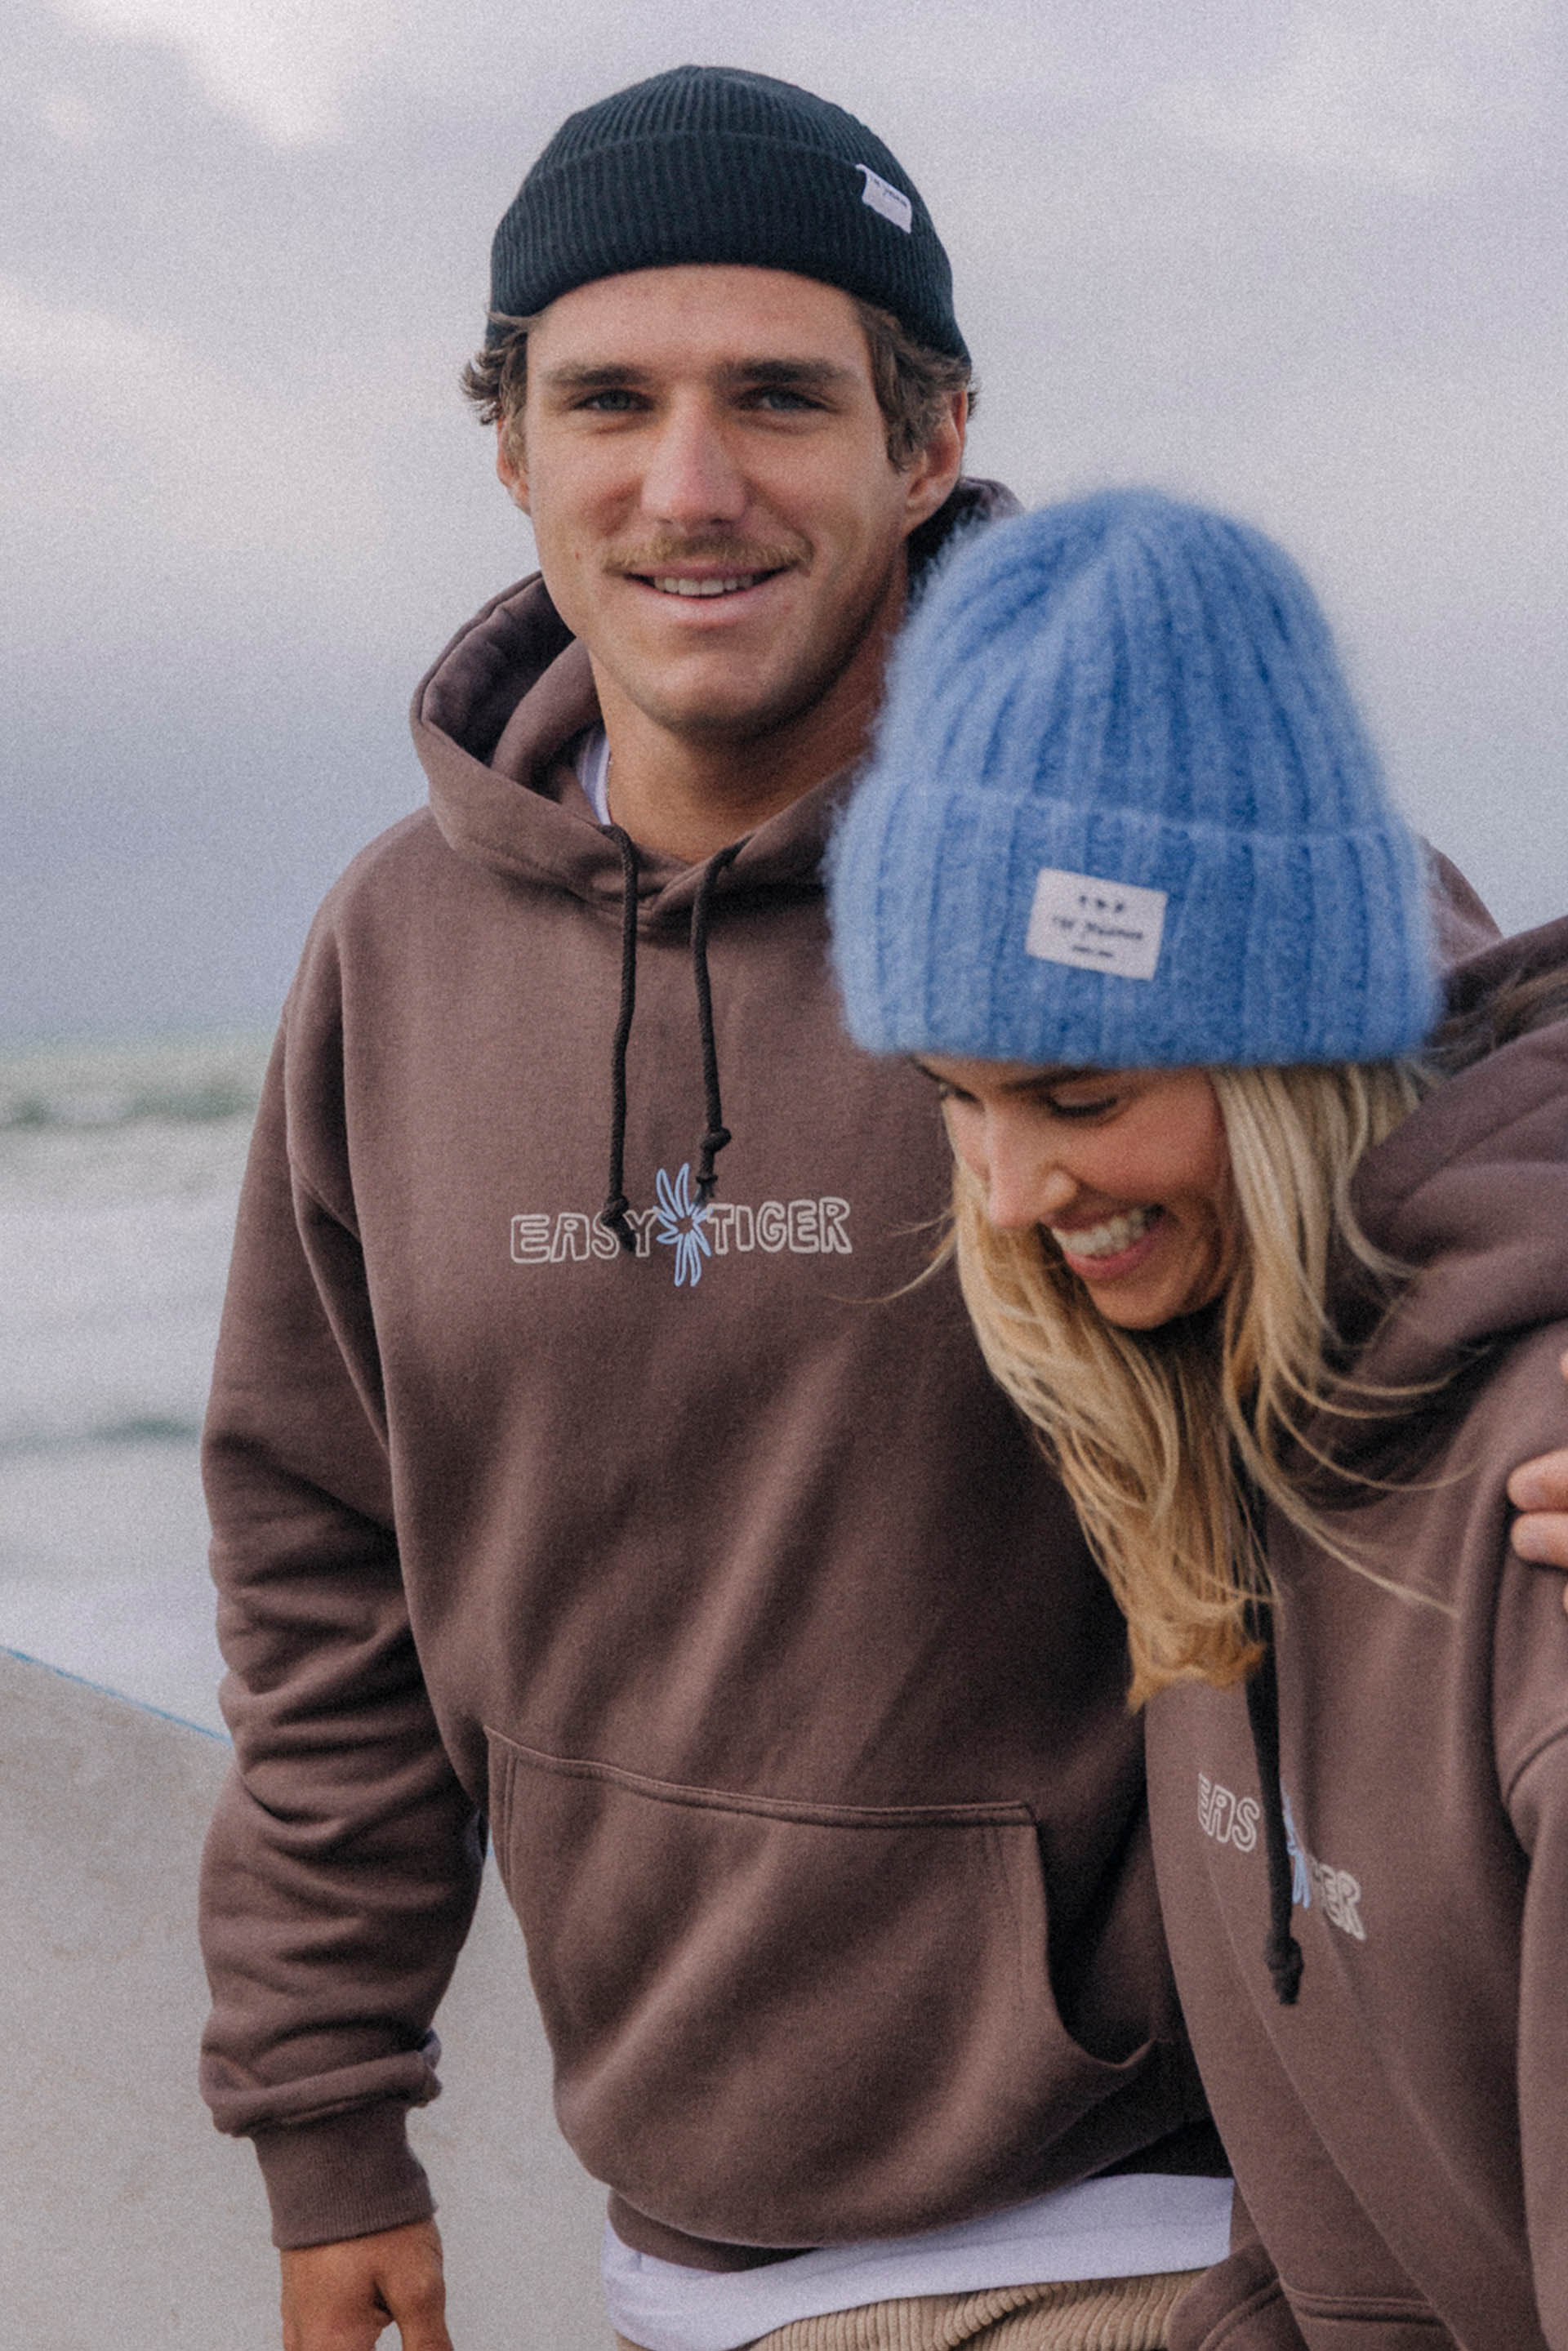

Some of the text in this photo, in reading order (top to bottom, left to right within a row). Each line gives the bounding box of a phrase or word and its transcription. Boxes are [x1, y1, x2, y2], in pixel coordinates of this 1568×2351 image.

[510, 1197, 853, 1264] EASY TIGER
[1198, 1773, 1261, 1852] EAS
